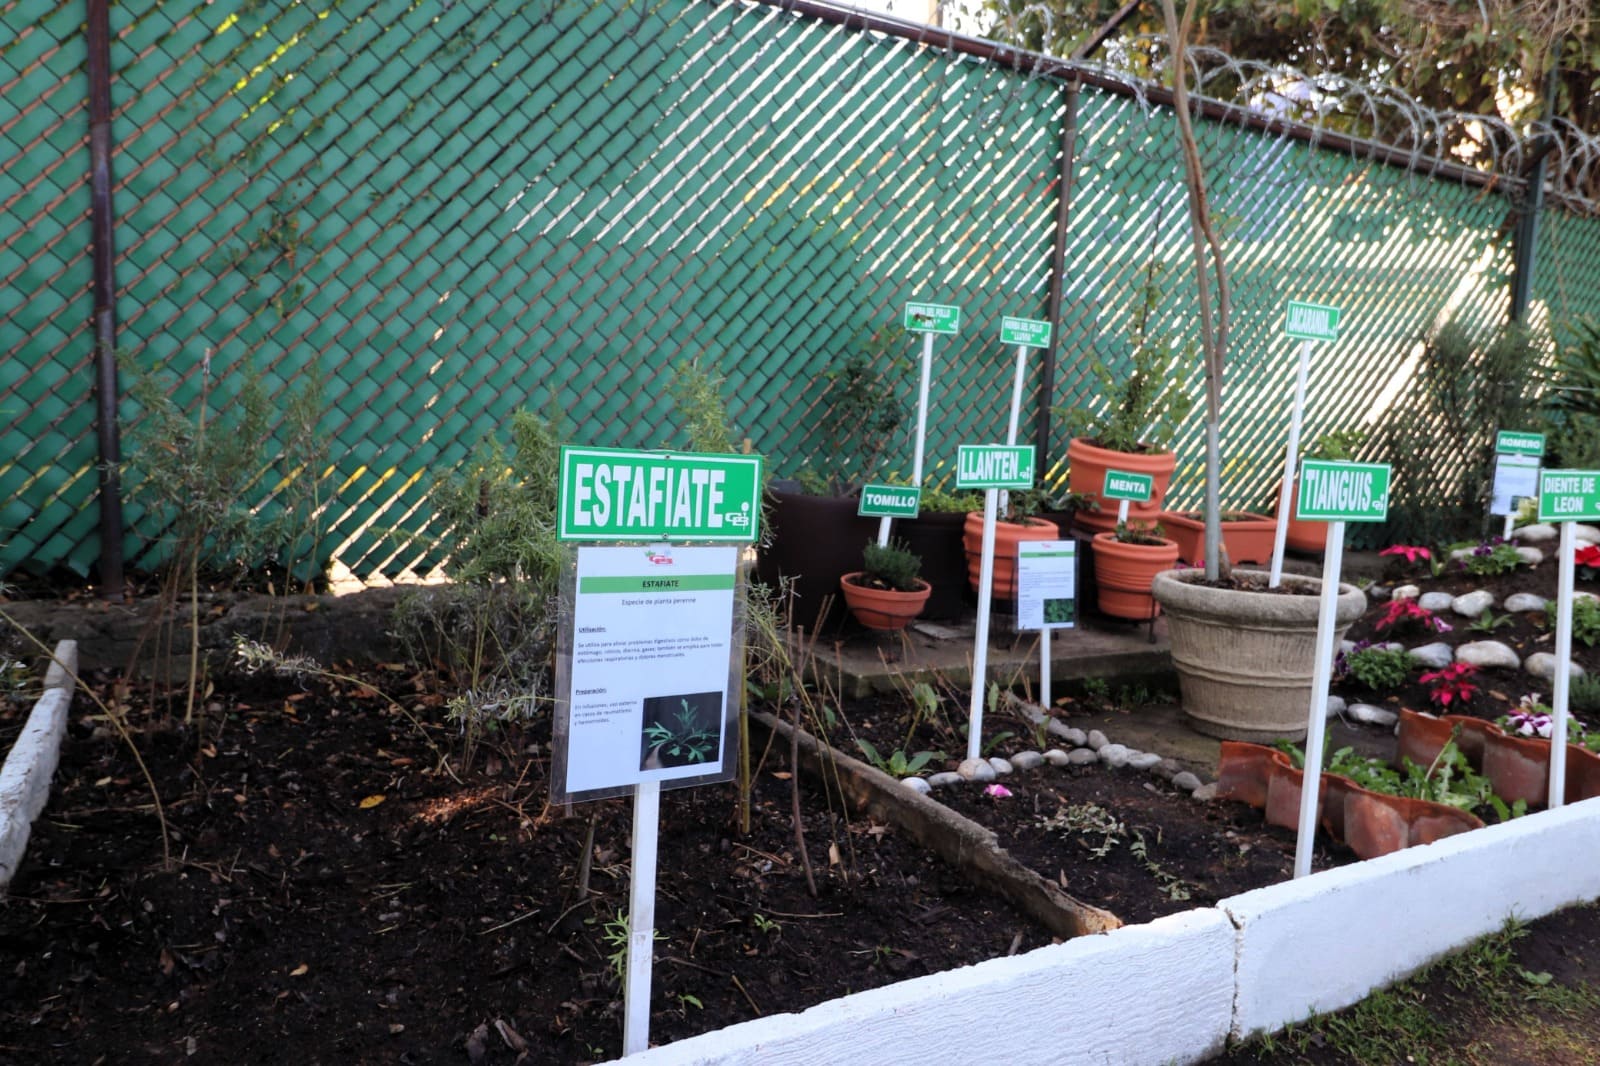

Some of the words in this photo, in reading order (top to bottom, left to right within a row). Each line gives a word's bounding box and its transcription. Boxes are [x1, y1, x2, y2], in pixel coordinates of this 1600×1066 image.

[1500, 438, 1540, 448] ROMERO
[960, 451, 1019, 480] LLANTEN
[1110, 478, 1146, 494] MENTA
[1305, 469, 1372, 512] TIANGUIS
[1544, 478, 1580, 494] DIENTE
[1582, 478, 1596, 494] DE
[574, 463, 726, 528] ESTAFIATE
[866, 493, 916, 508] TOMILLO
[1554, 496, 1584, 512] LEON
[642, 580, 679, 588] ESTAFIATE
[654, 598, 672, 606] planta
